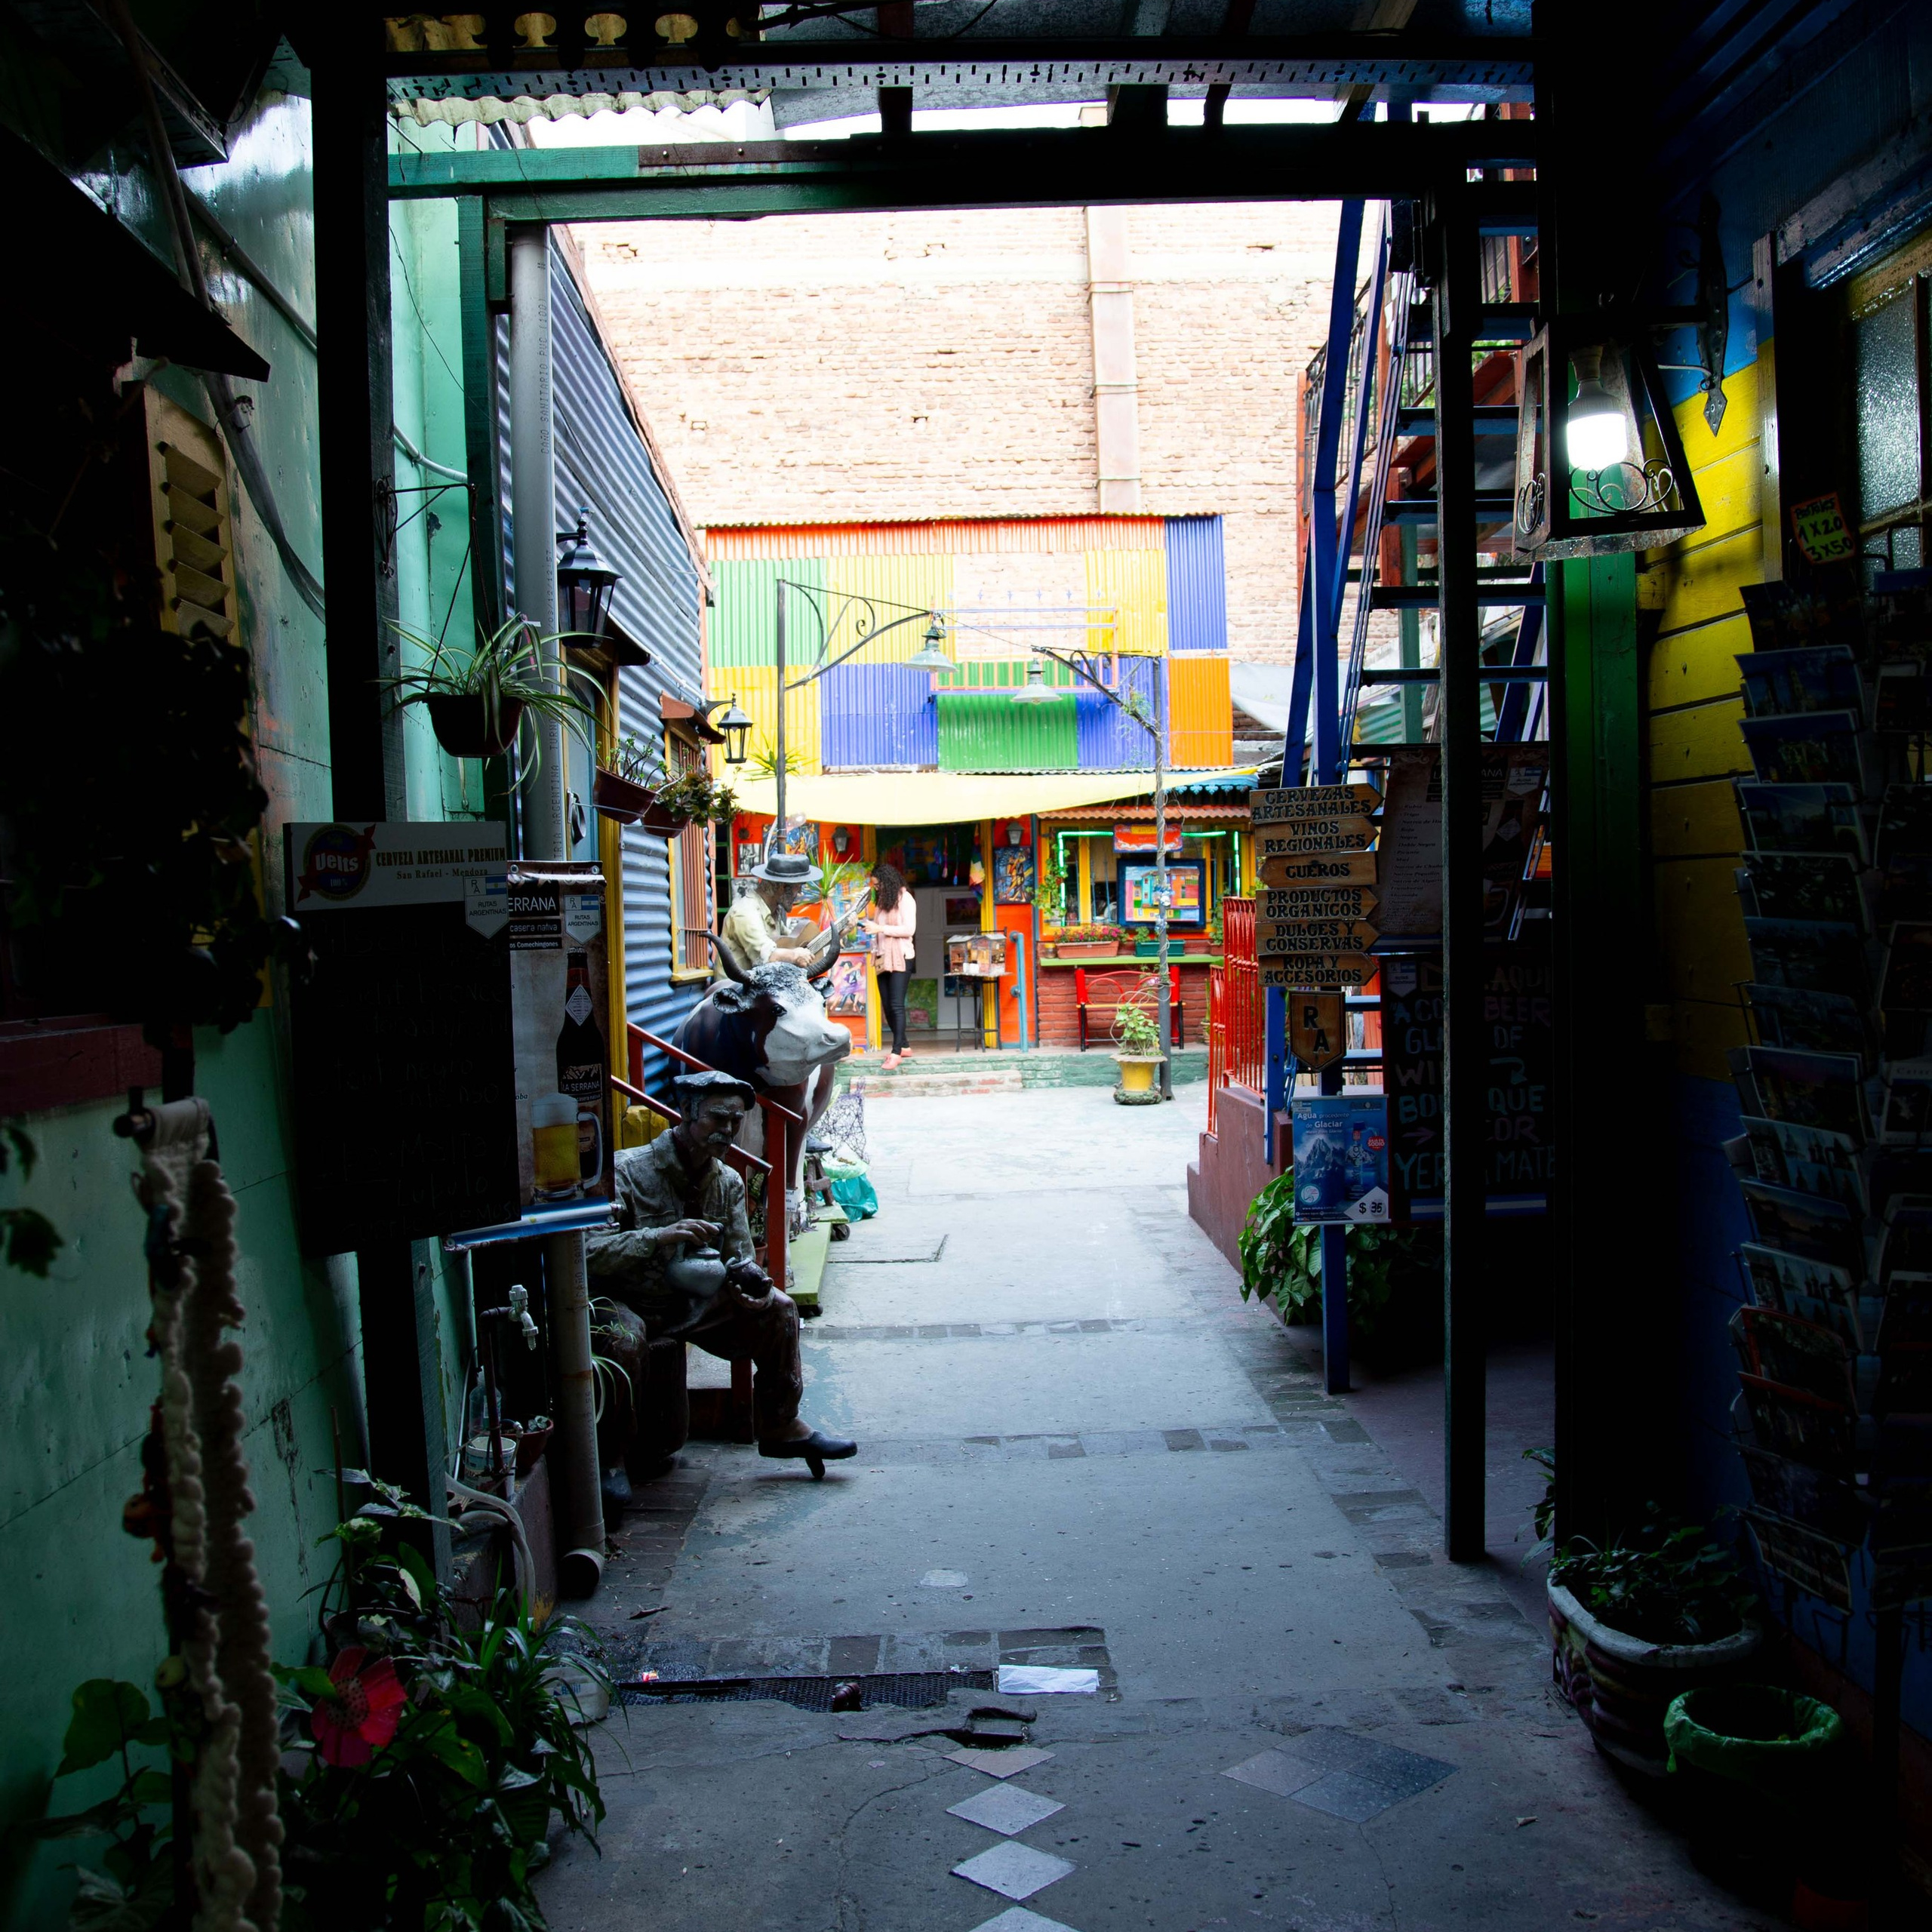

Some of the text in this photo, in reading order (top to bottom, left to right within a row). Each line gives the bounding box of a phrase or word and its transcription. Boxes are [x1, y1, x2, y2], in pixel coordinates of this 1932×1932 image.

[1265, 786, 1355, 804] CERVEZAS
[1252, 800, 1372, 820] ARTESANALES
[1290, 820, 1340, 836] VINOS
[1264, 833, 1367, 853] REGIONALES
[376, 847, 506, 866] CERVEZA ARTESANAL PREMIUM
[396, 871, 412, 880] San
[415, 869, 442, 878] Rafael
[452, 867, 488, 877] Mendoza
[1285, 862, 1351, 879] CUEROS
[1267, 888, 1362, 905] PRODUCTOS
[469, 908, 507, 917] ARGENTINAS
[1266, 903, 1362, 918] ORGANICOS
[509, 921, 558, 933] casera nativa
[1274, 921, 1356, 937] DULCES Y
[516, 940, 559, 949] Comechingones
[1266, 936, 1364, 952] CONSERVAS
[1283, 955, 1340, 970] ROPA Y
[1264, 968, 1362, 984] ACCESORIOS
[571, 1080, 600, 1092] SERRANA
[1297, 1112, 1317, 1121] Agua
[1314, 1121, 1343, 1129] Glaciar
